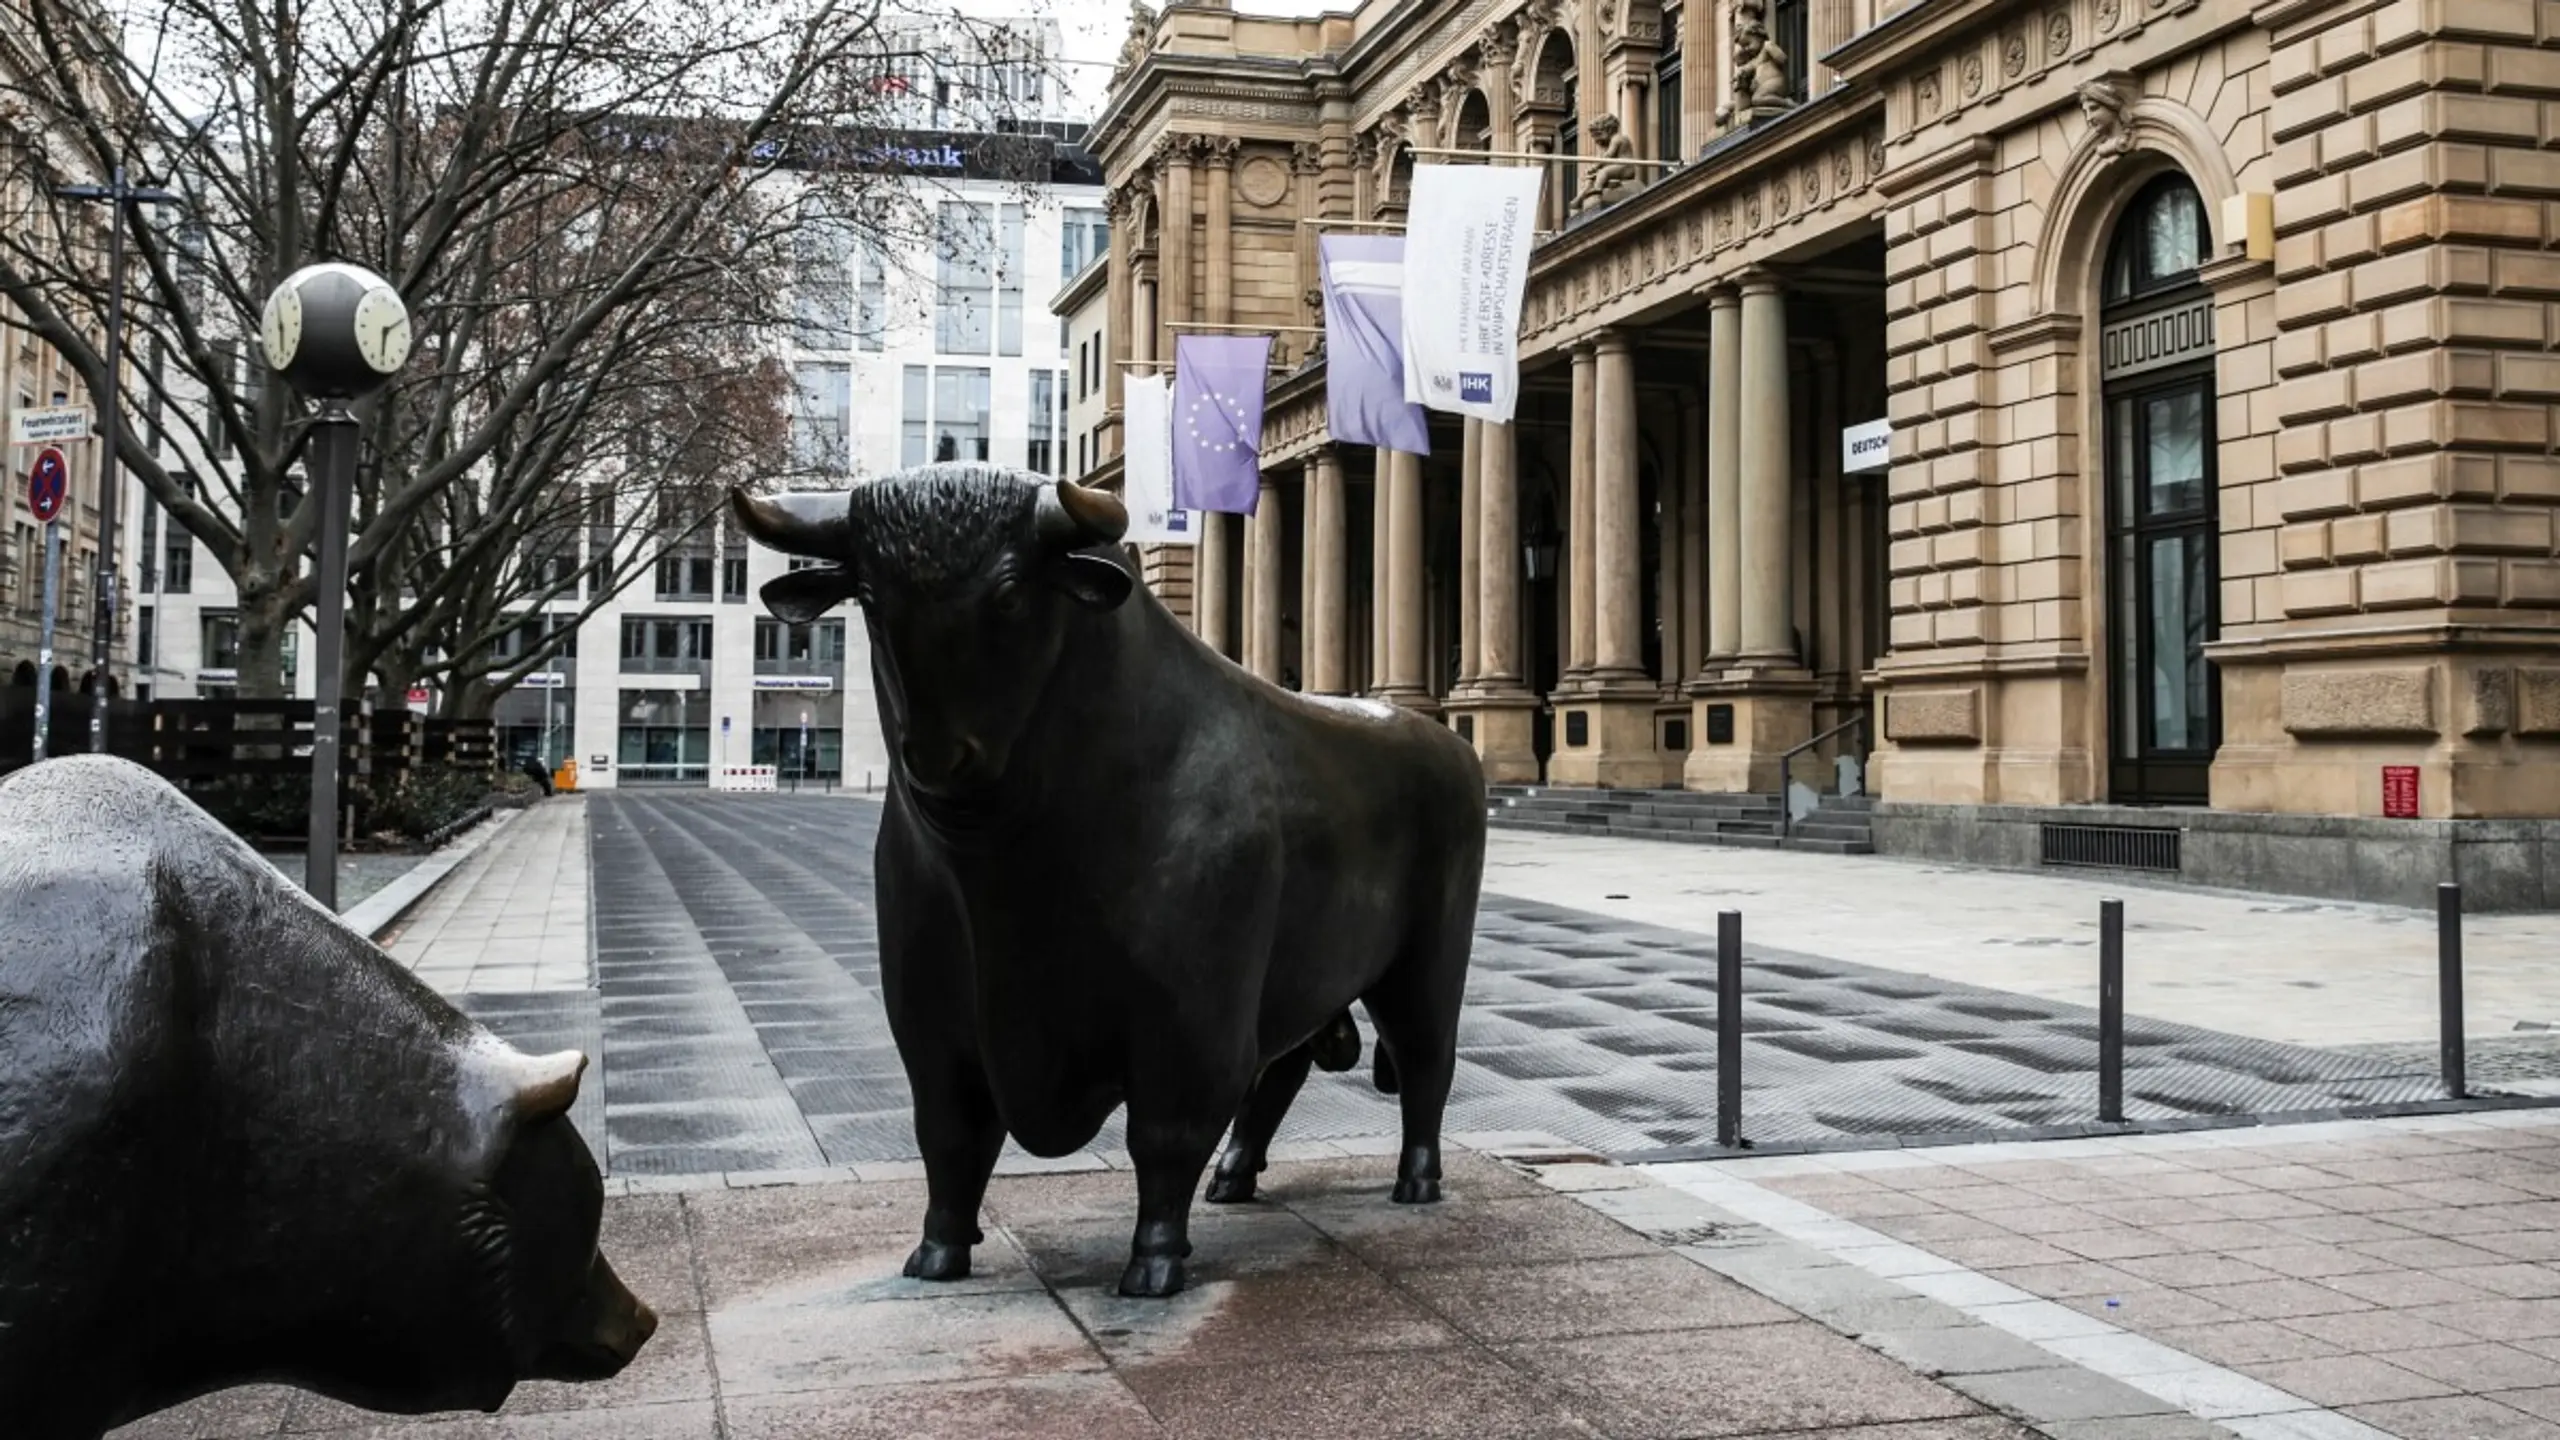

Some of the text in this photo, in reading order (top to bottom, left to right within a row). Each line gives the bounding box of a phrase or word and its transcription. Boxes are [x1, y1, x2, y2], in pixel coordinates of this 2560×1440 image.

[1481, 220, 1498, 280] ADRESSE
[1492, 196, 1519, 355] IN WIRTSCHAFTSFRAGEN
[1479, 281, 1492, 321] ERSTE
[1463, 377, 1489, 391] IHK
